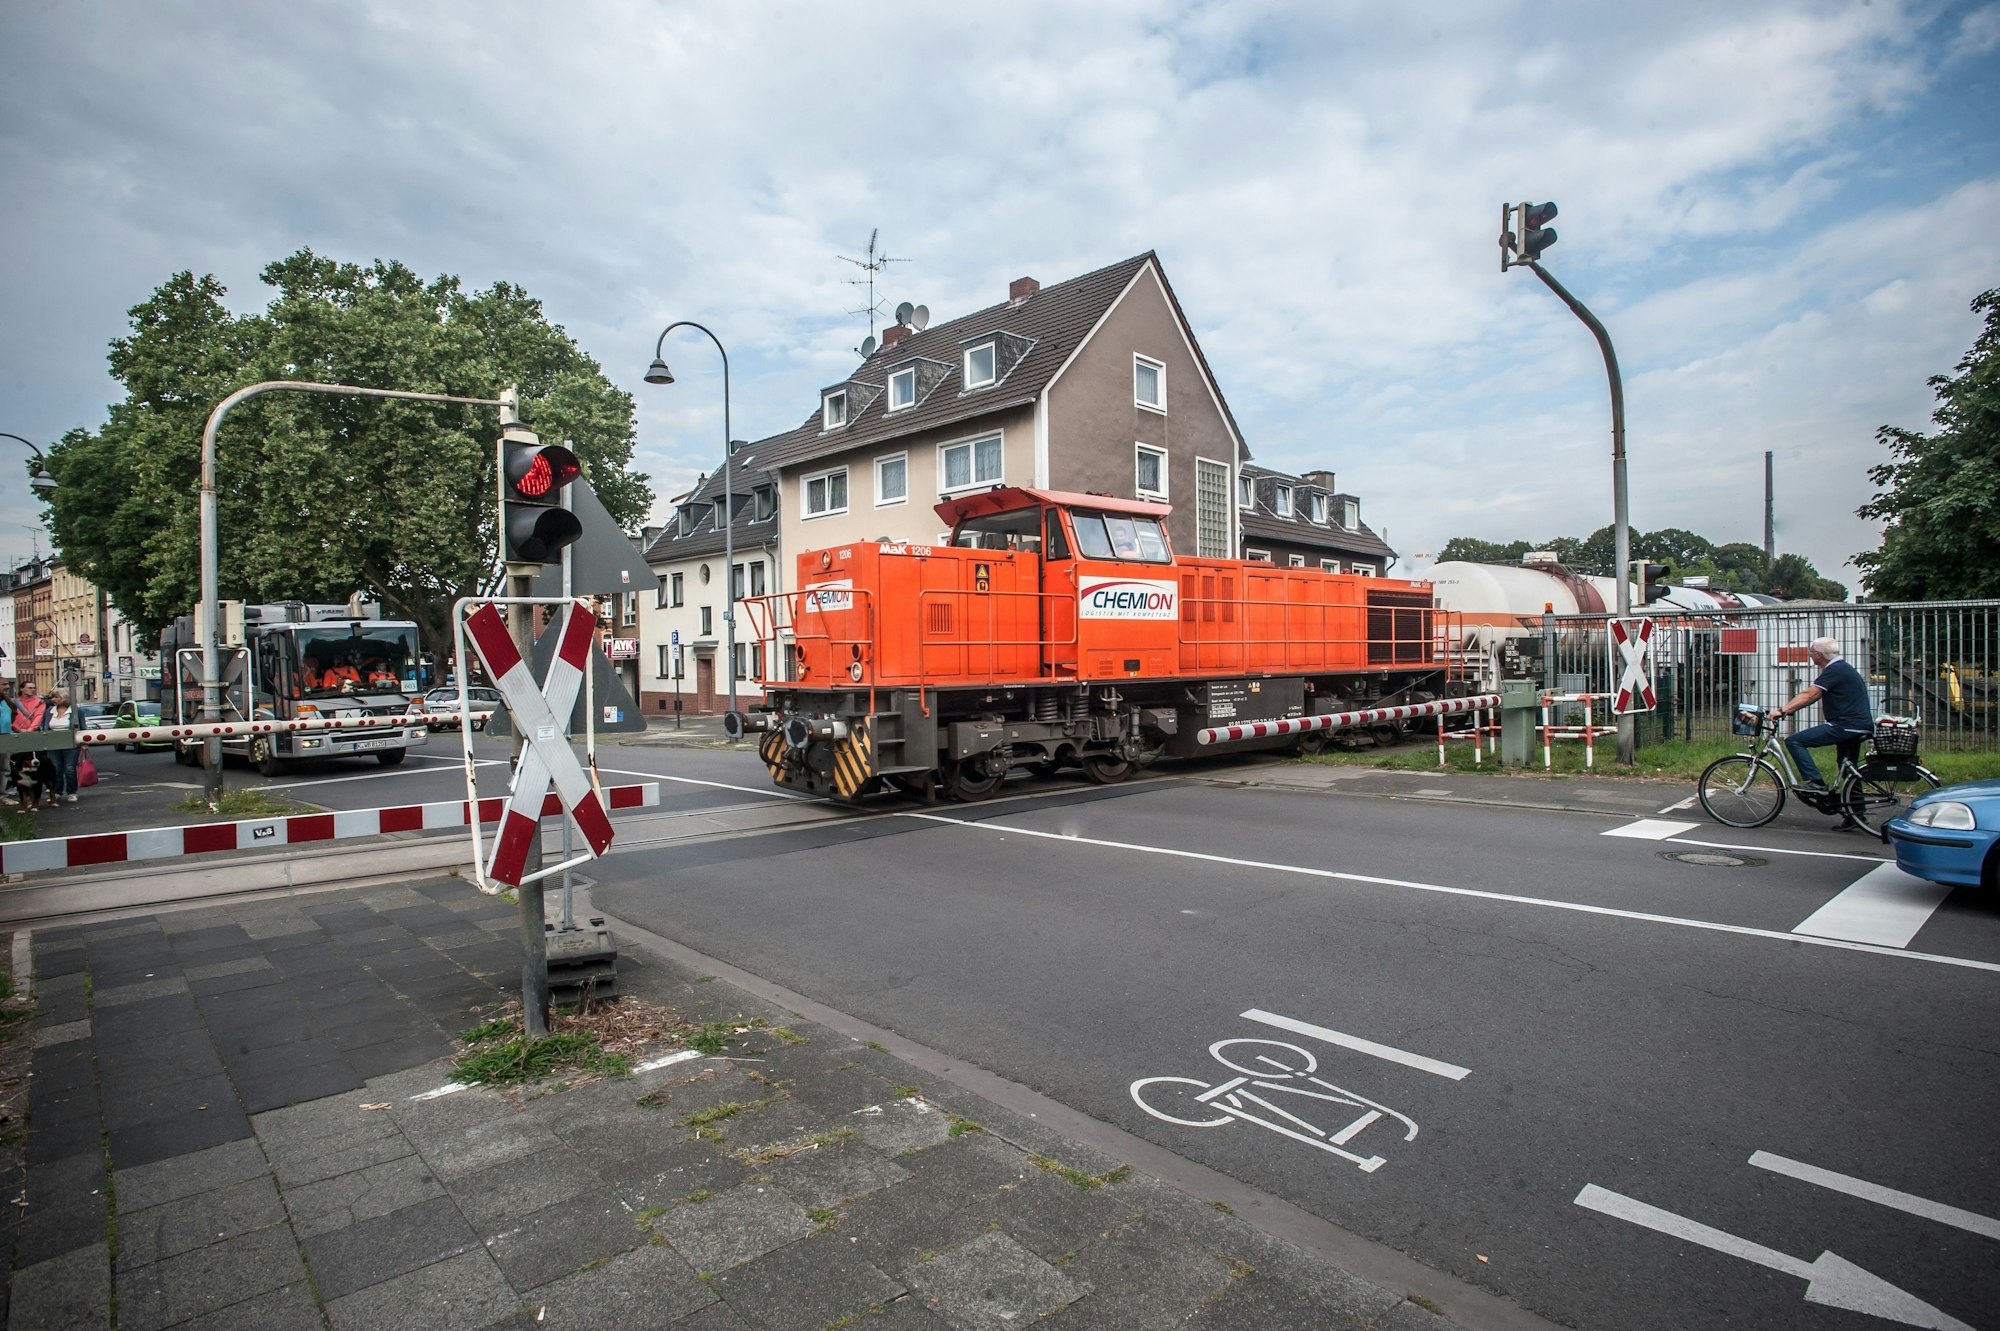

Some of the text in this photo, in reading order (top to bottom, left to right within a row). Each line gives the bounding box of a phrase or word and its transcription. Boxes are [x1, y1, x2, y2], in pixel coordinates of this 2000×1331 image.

[839, 549, 852, 559] 1206
[879, 544, 932, 556] MaK 1206
[1093, 591, 1174, 611] CHEMION
[614, 640, 634, 651] AYK
[404, 682, 416, 690] 603
